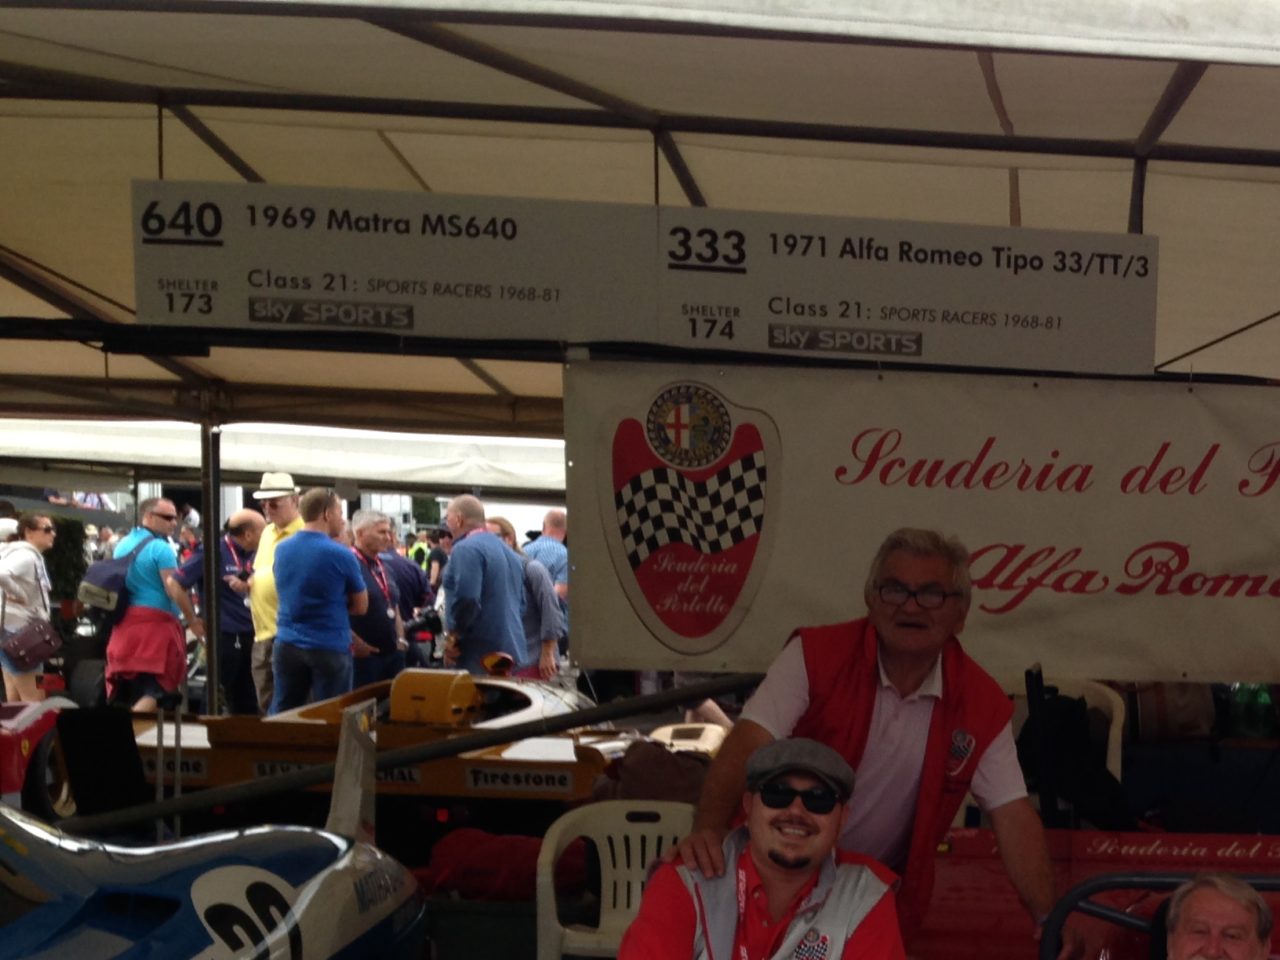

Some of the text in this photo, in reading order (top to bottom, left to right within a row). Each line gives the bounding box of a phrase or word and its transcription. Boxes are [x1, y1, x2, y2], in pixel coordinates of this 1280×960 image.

[141, 201, 223, 237] 640
[246, 205, 518, 241] 1969 Matra MS640
[669, 227, 747, 265] 333
[769, 234, 1150, 279] 1971 Alfa Romeo Tipo 33/TT/3
[157, 277, 219, 292] SHELTER
[247, 269, 561, 303] Class 21: SPORTS RACERS 1968-81
[165, 294, 213, 315] 173
[253, 301, 410, 327] sky SPORTS
[681, 303, 741, 318] SHELTER
[768, 296, 1063, 331] Class 21: SPORTS RACERS 1968-81
[688, 319, 735, 341] 174
[774, 328, 918, 353] sky SPORTS
[835, 428, 1095, 494] Scuderia
[1120, 441, 1221, 496] del
[676, 575, 708, 594] del
[968, 542, 1110, 615] Alfa
[470, 769, 568, 788] Firestone
[1086, 838, 1209, 858] Scuderia
[1217, 841, 1262, 859] del
